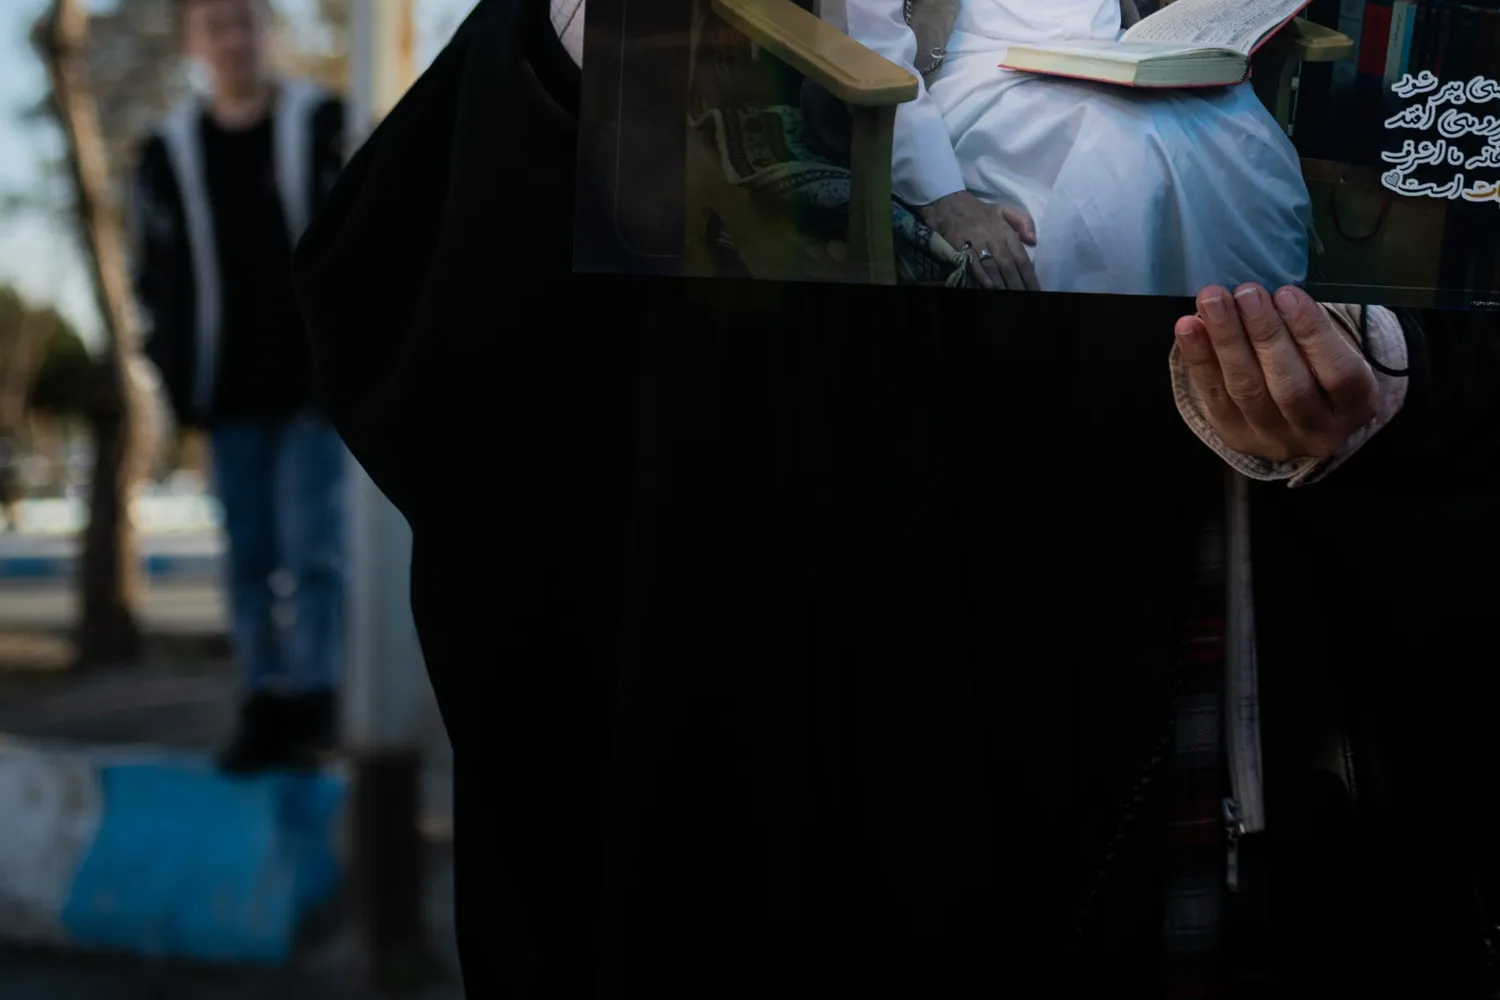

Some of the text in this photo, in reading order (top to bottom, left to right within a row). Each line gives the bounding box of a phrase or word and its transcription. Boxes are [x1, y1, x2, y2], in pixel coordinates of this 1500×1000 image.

[1391, 70, 1438, 98] شود
[1429, 81, 1466, 105] پیر
[1384, 101, 1436, 129] افتد
[1381, 139, 1446, 174] اشرف
[1447, 146, 1465, 166] ما
[1398, 173, 1464, 199] است
